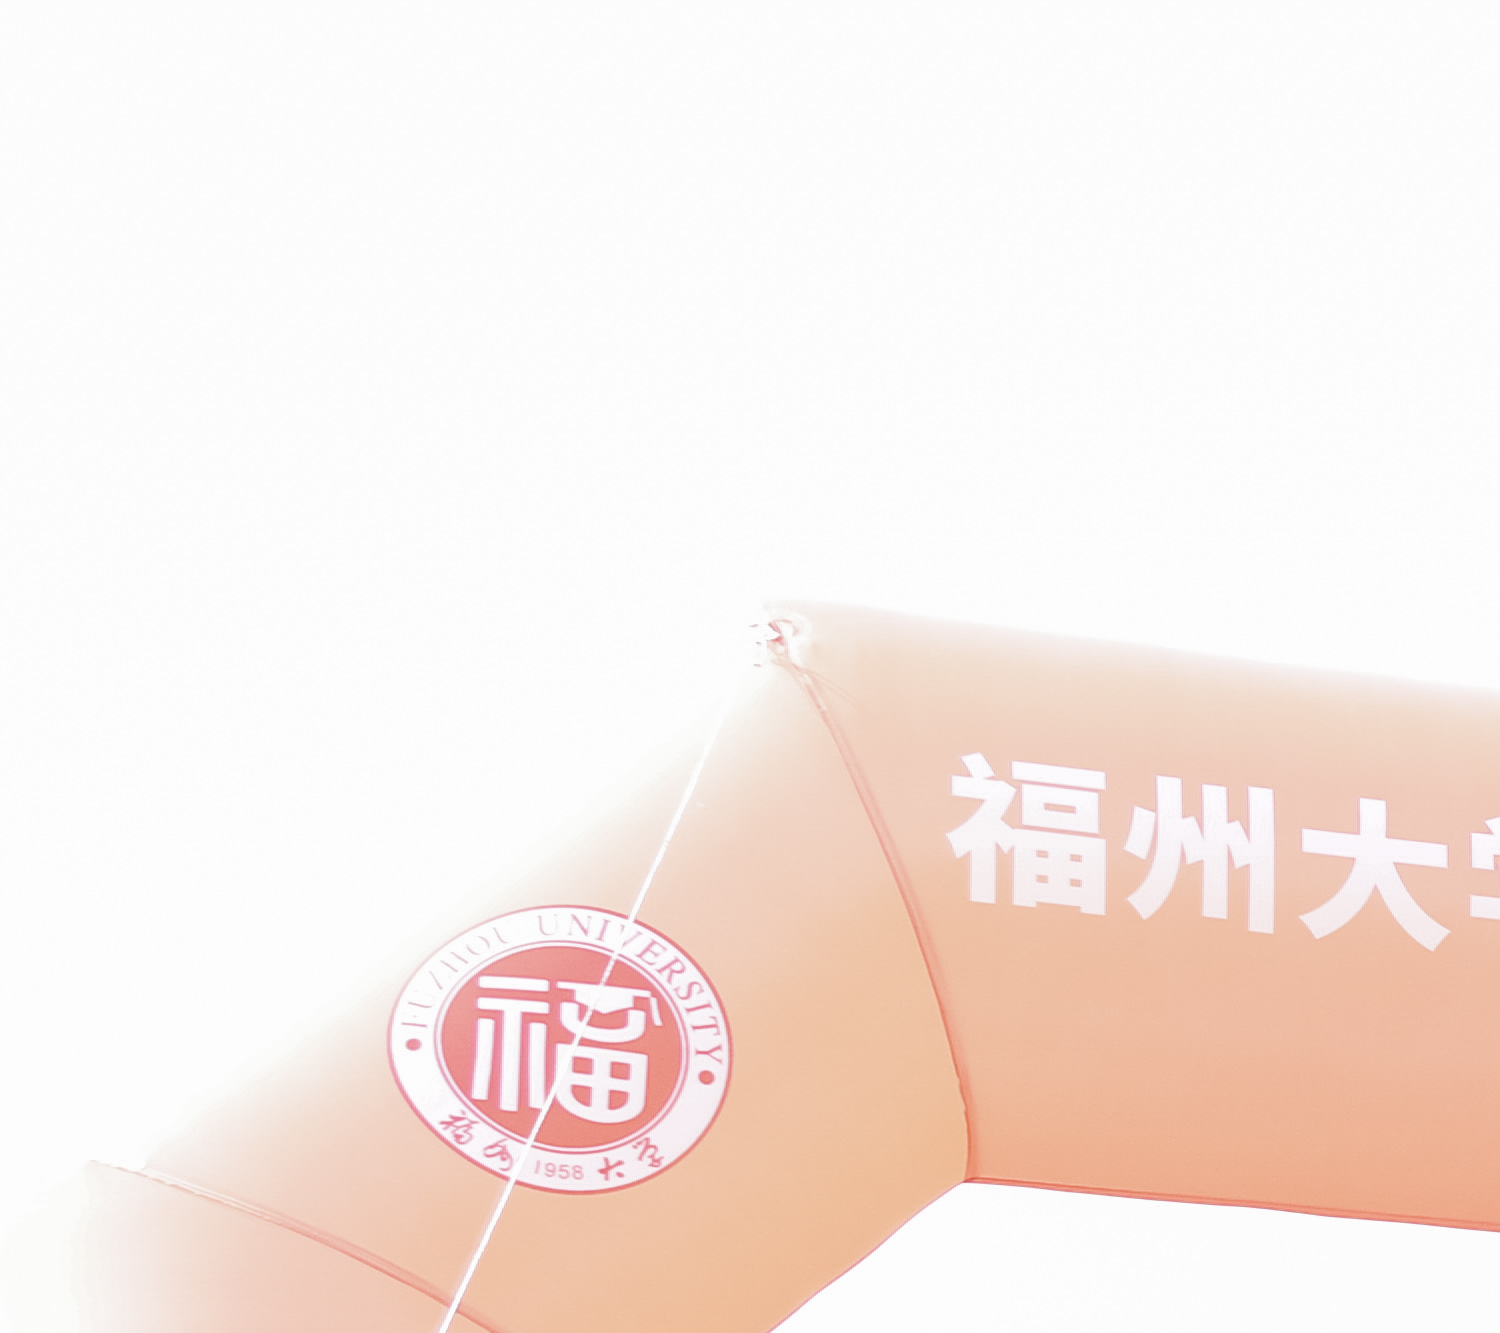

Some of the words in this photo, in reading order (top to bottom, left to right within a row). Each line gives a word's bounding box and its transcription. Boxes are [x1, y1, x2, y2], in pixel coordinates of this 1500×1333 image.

[471, 975, 663, 1125] 福
[536, 912, 723, 1065] UNIVERSITY
[534, 1159, 584, 1181] 1958
